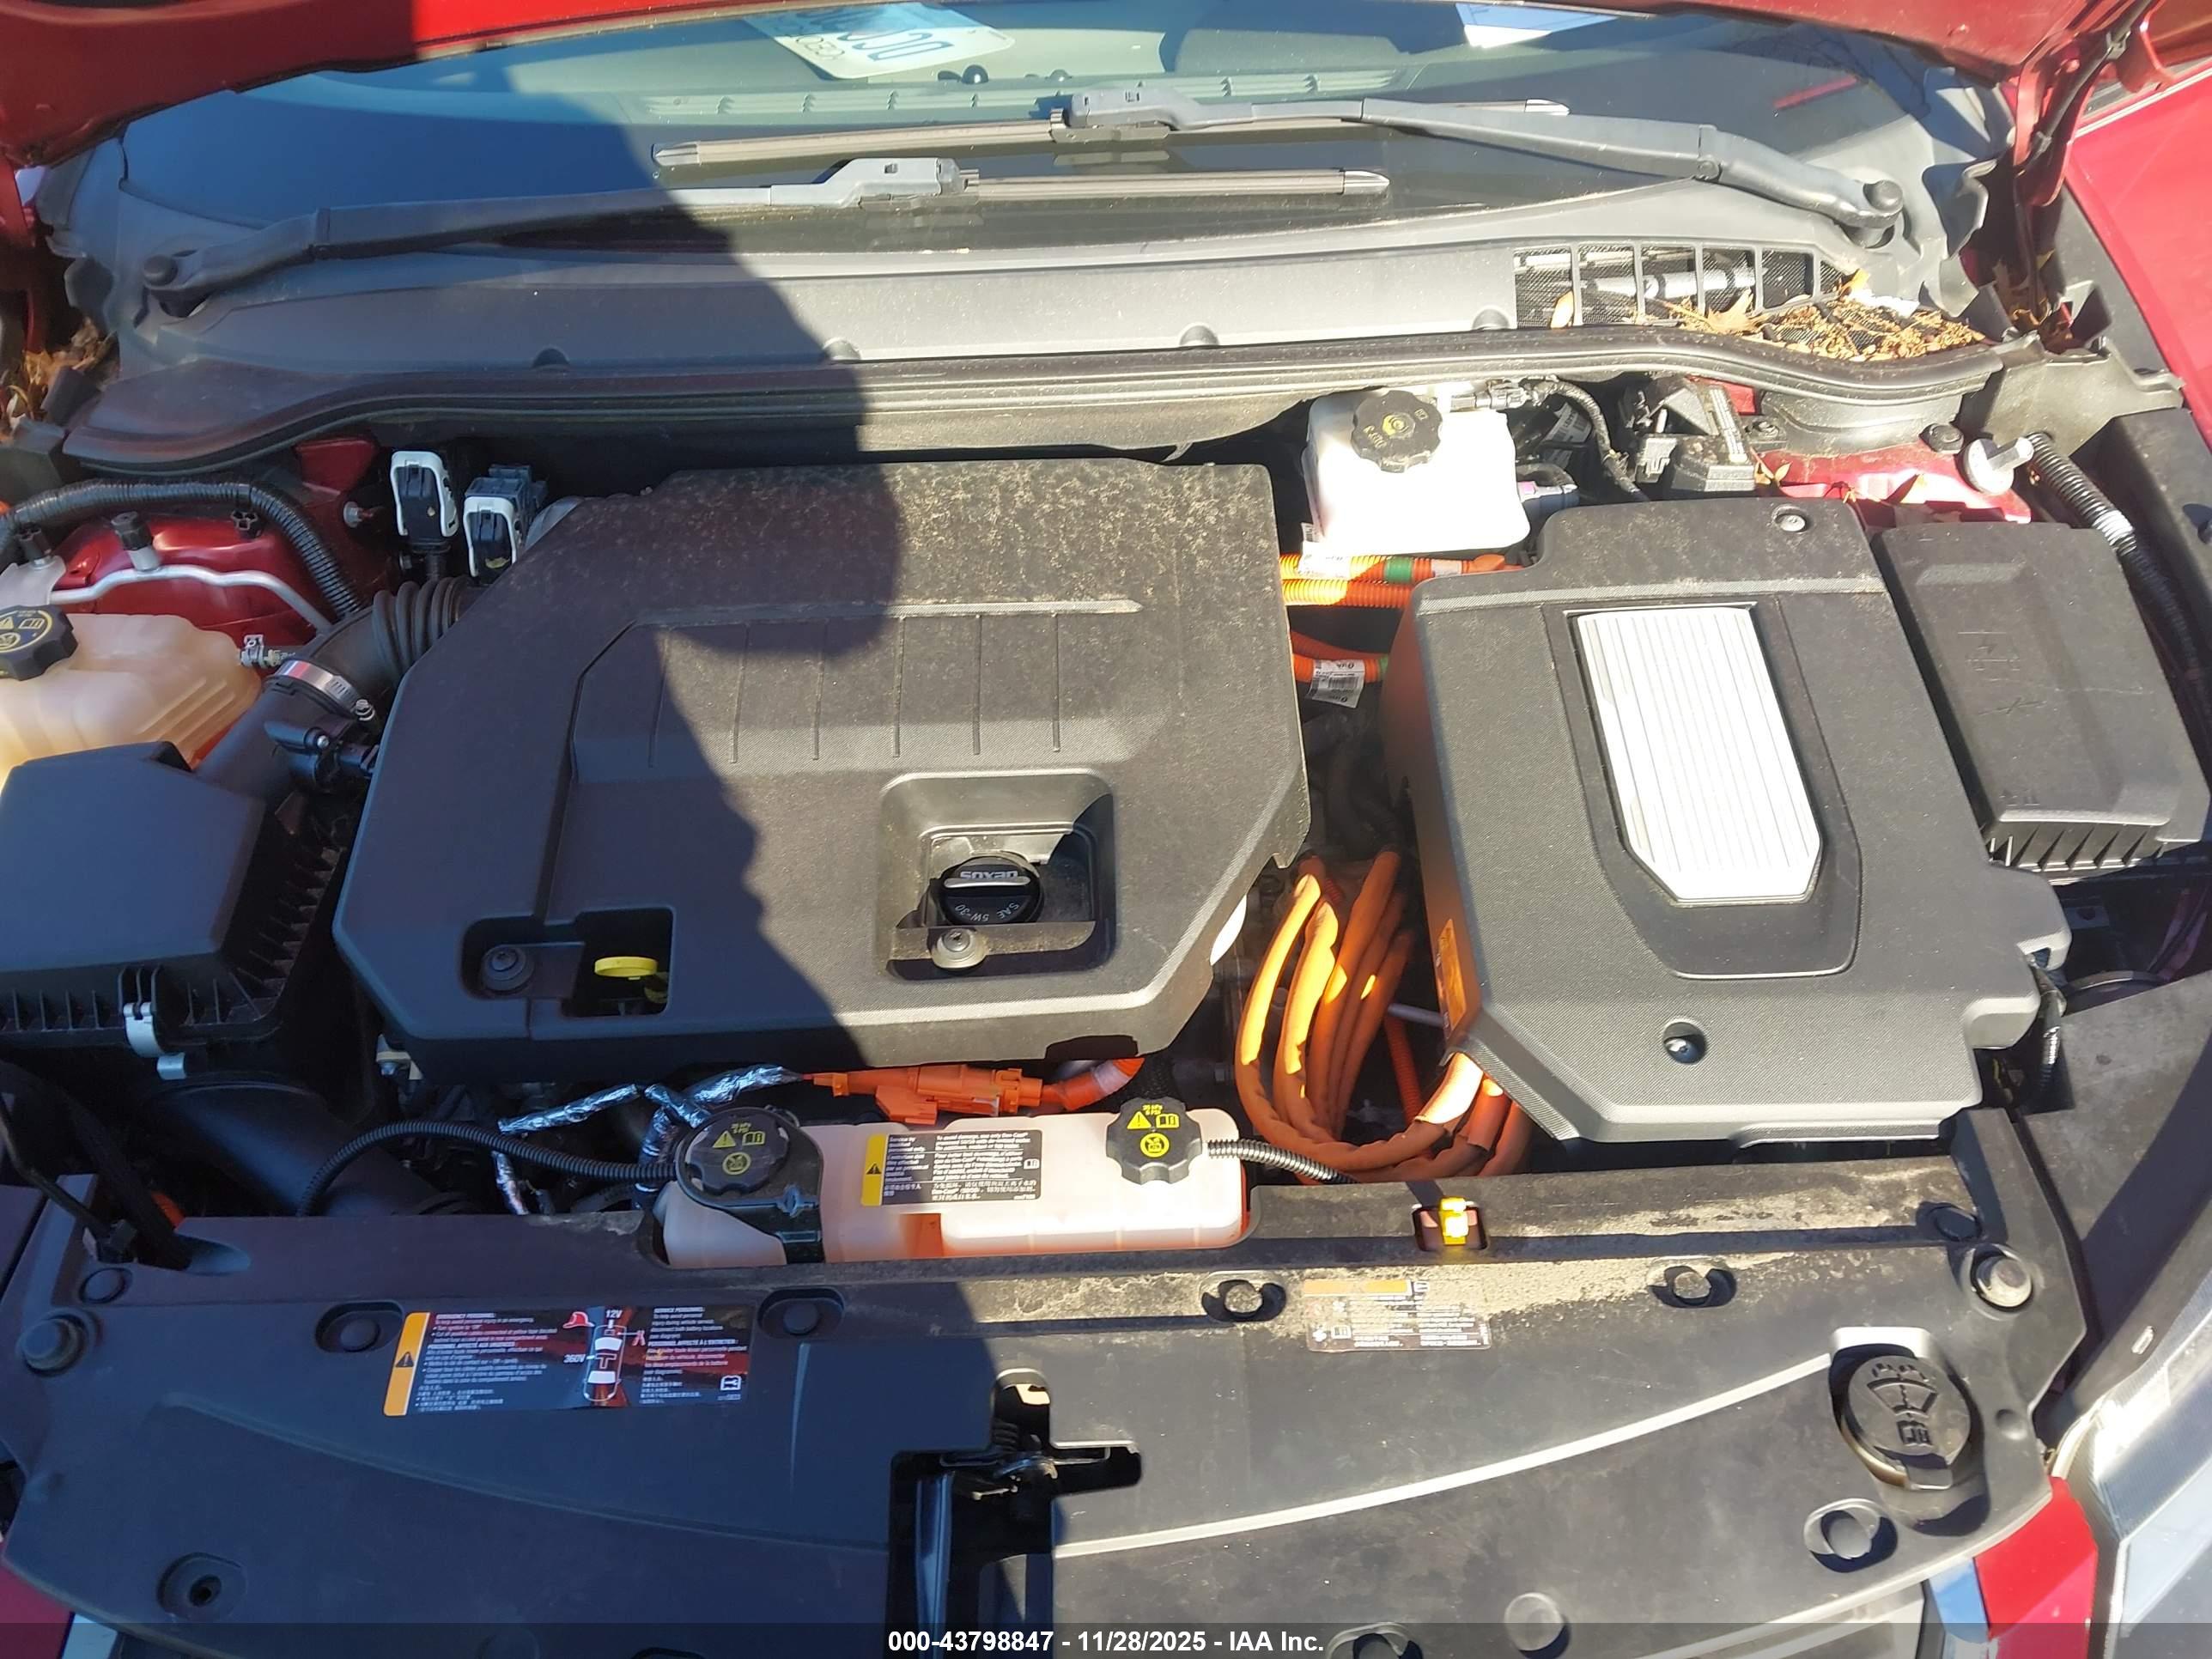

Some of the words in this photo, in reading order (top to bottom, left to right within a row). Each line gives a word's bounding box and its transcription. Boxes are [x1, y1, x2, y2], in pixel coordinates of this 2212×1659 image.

[954, 903, 990, 922] 5W-30
[996, 902, 1020, 919] SAE
[605, 1310, 623, 1318] 12V
